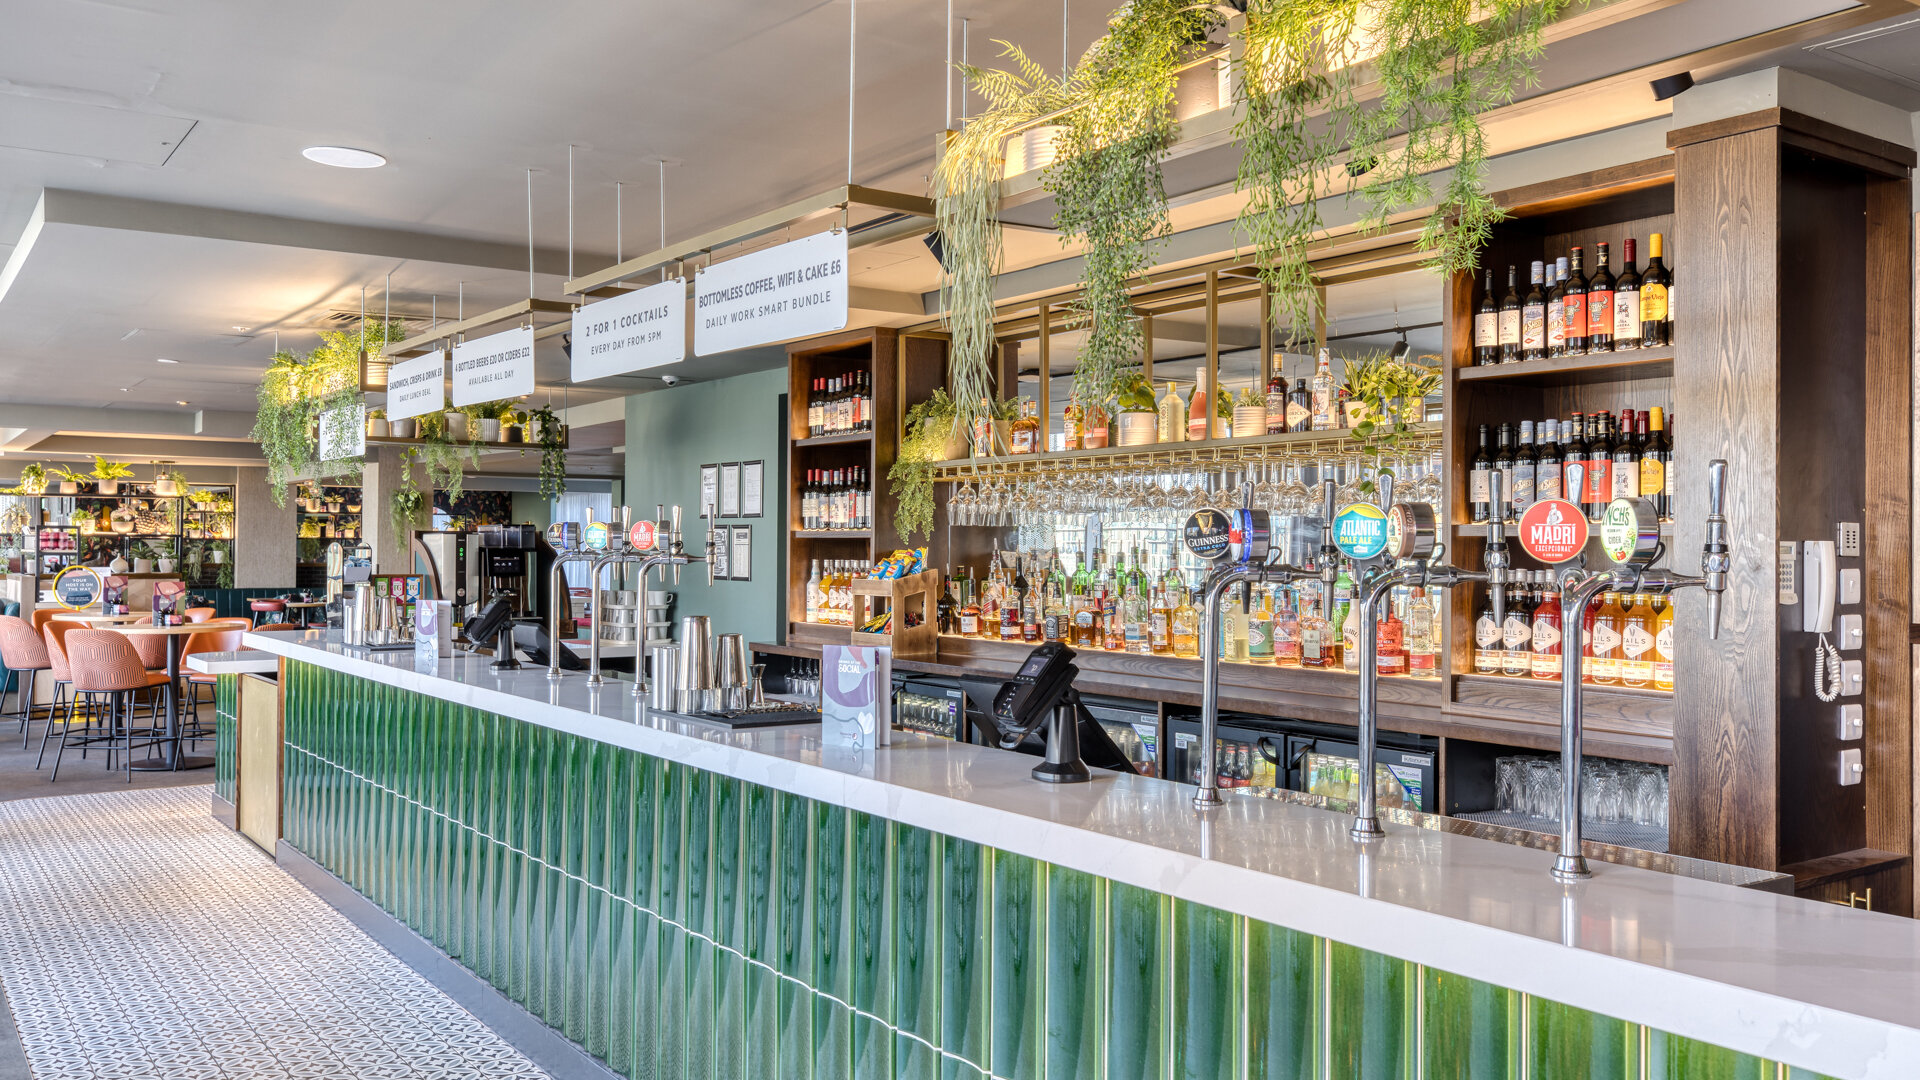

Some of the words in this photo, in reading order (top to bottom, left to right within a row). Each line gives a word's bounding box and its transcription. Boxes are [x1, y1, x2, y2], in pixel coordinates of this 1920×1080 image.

[699, 285, 743, 308] BOTTOMLESS
[745, 277, 776, 296] COFFEE,
[777, 269, 796, 288] WIFI
[797, 269, 803, 283] &
[805, 262, 829, 281] CAKE
[831, 259, 841, 276] £6
[706, 315, 728, 329] DAILY
[731, 308, 755, 323] WORK
[758, 301, 788, 317] SMART
[792, 291, 831, 309] BUNDLE
[586, 326, 590, 337] 2
[593, 321, 609, 336] FOR
[613, 319, 617, 330] 1
[620, 305, 669, 328] COCKTAILS
[591, 343, 611, 355] EVERY
[613, 339, 625, 351] DAY
[627, 334, 645, 347] FROM
[459, 359, 476, 372] BOTTLED
[476, 356, 489, 368] BEERS
[498, 352, 504, 363] OR
[505, 349, 521, 362] CIDERS
[468, 374, 493, 386] AVAILABLE
[494, 372, 503, 381] ALL
[504, 370, 514, 379] DAY
[1340, 520, 1380, 536] ATLANTIC
[1531, 523, 1576, 545] MADRÍ
[1188, 534, 1229, 547] GUINNESS
[1340, 536, 1357, 544] PALE
[1358, 536, 1372, 544] ALE
[838, 663, 861, 674] SOCIAL
